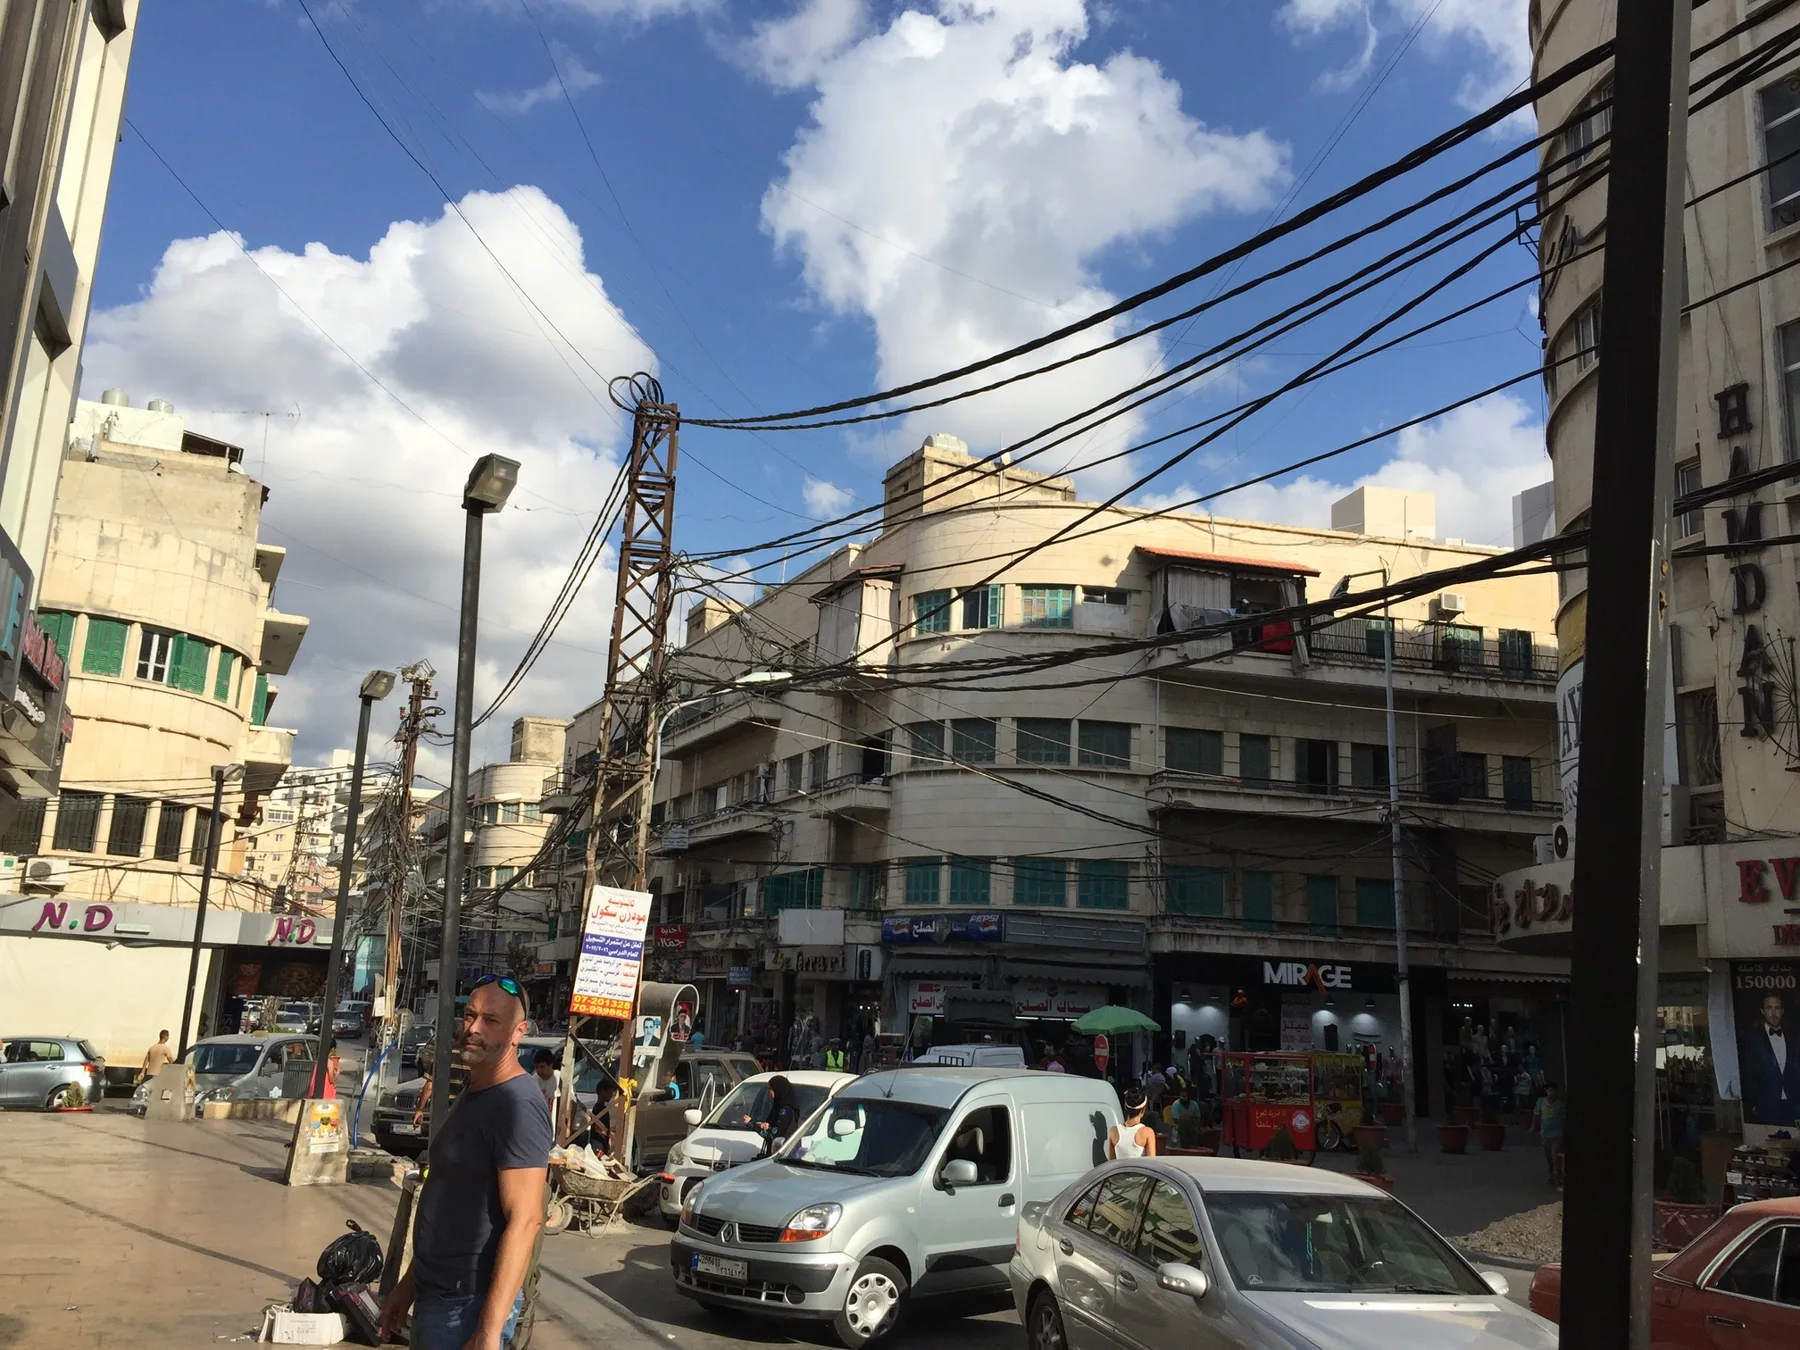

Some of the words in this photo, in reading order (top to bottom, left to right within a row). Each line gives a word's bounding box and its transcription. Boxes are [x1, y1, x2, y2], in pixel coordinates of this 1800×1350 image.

[1714, 382, 1777, 738] HAMDAN
[591, 905, 617, 920] سكول
[619, 911, 647, 925] مودرن
[969, 914, 1000, 923] PEPSI
[883, 917, 911, 926] PEPSI
[1263, 961, 1352, 996] MIRAGE
[1735, 975, 1796, 989] 150000
[573, 995, 631, 1010] 07-201328
